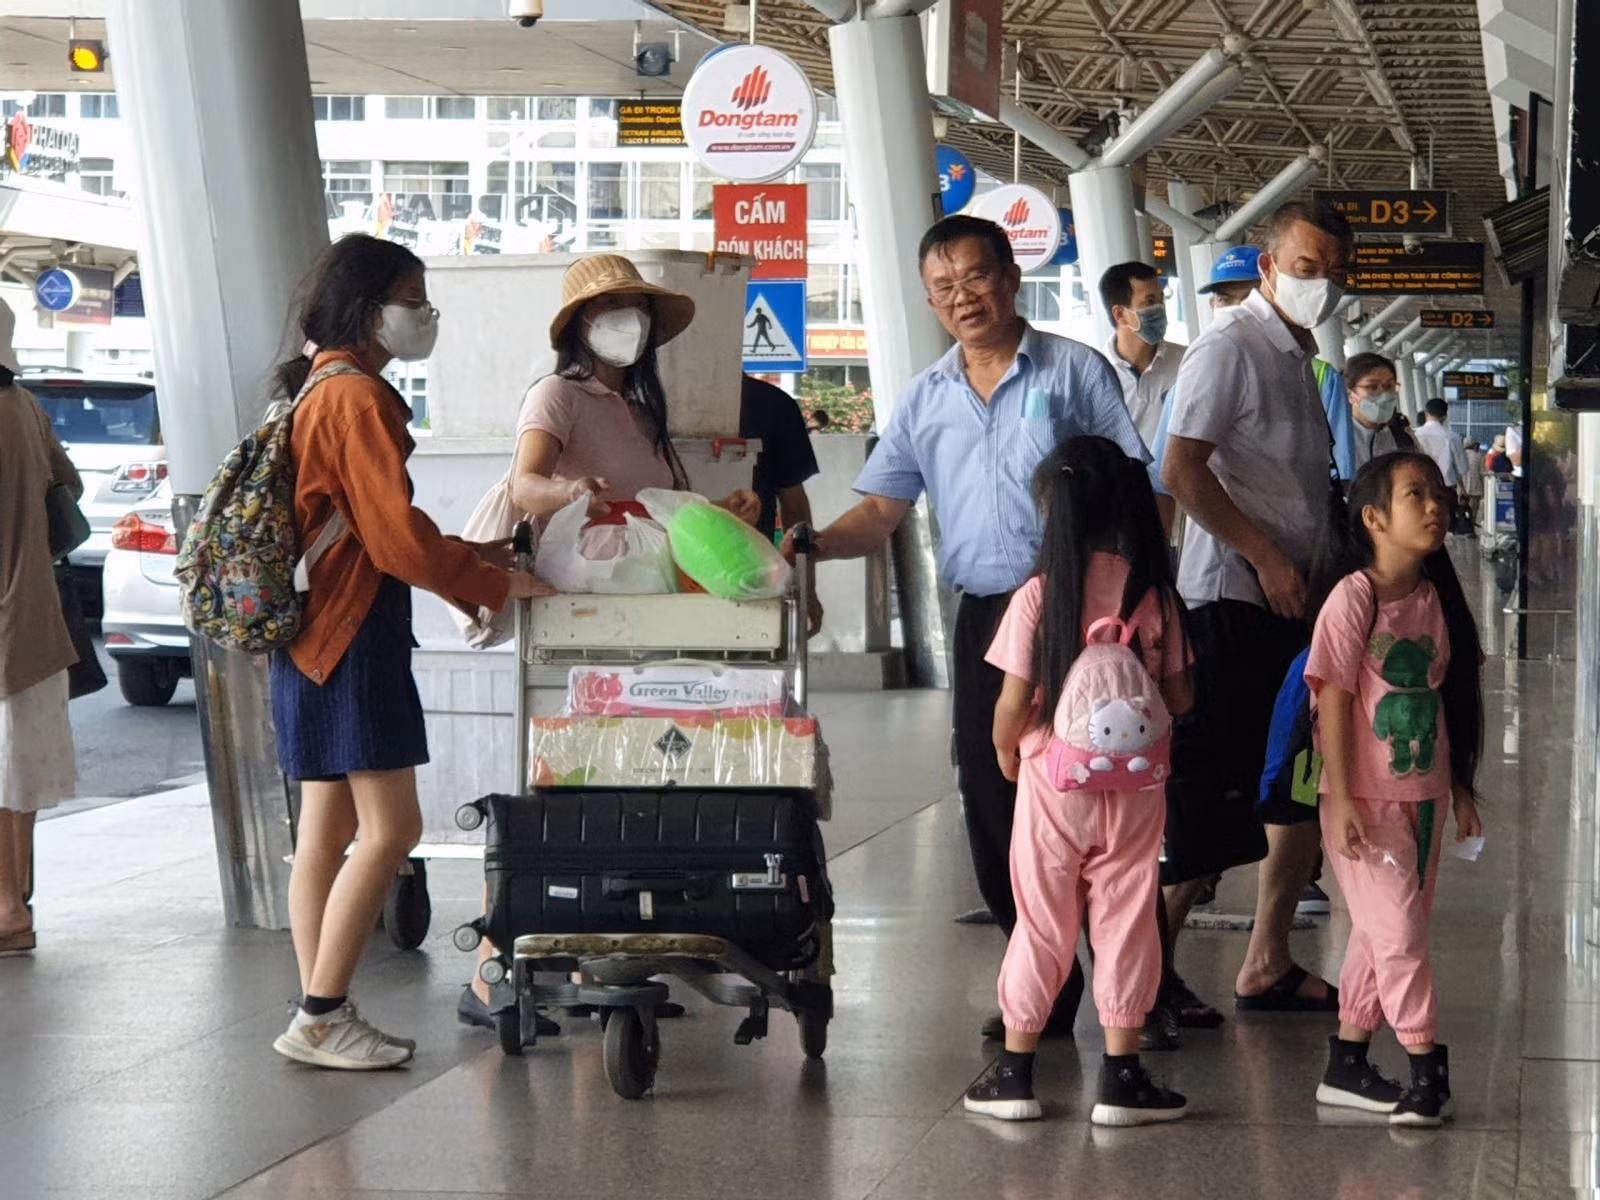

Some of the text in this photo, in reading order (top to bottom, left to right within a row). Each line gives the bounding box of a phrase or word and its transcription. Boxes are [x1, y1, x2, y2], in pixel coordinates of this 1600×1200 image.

[698, 110, 799, 131] Dongtam
[734, 192, 786, 225] CẤM
[1370, 199, 1410, 225] D3
[753, 235, 804, 261] KHÁCH
[1451, 312, 1474, 328] D2
[1464, 375, 1480, 385] D1
[629, 680, 678, 698] Green
[683, 680, 730, 700] Valley
